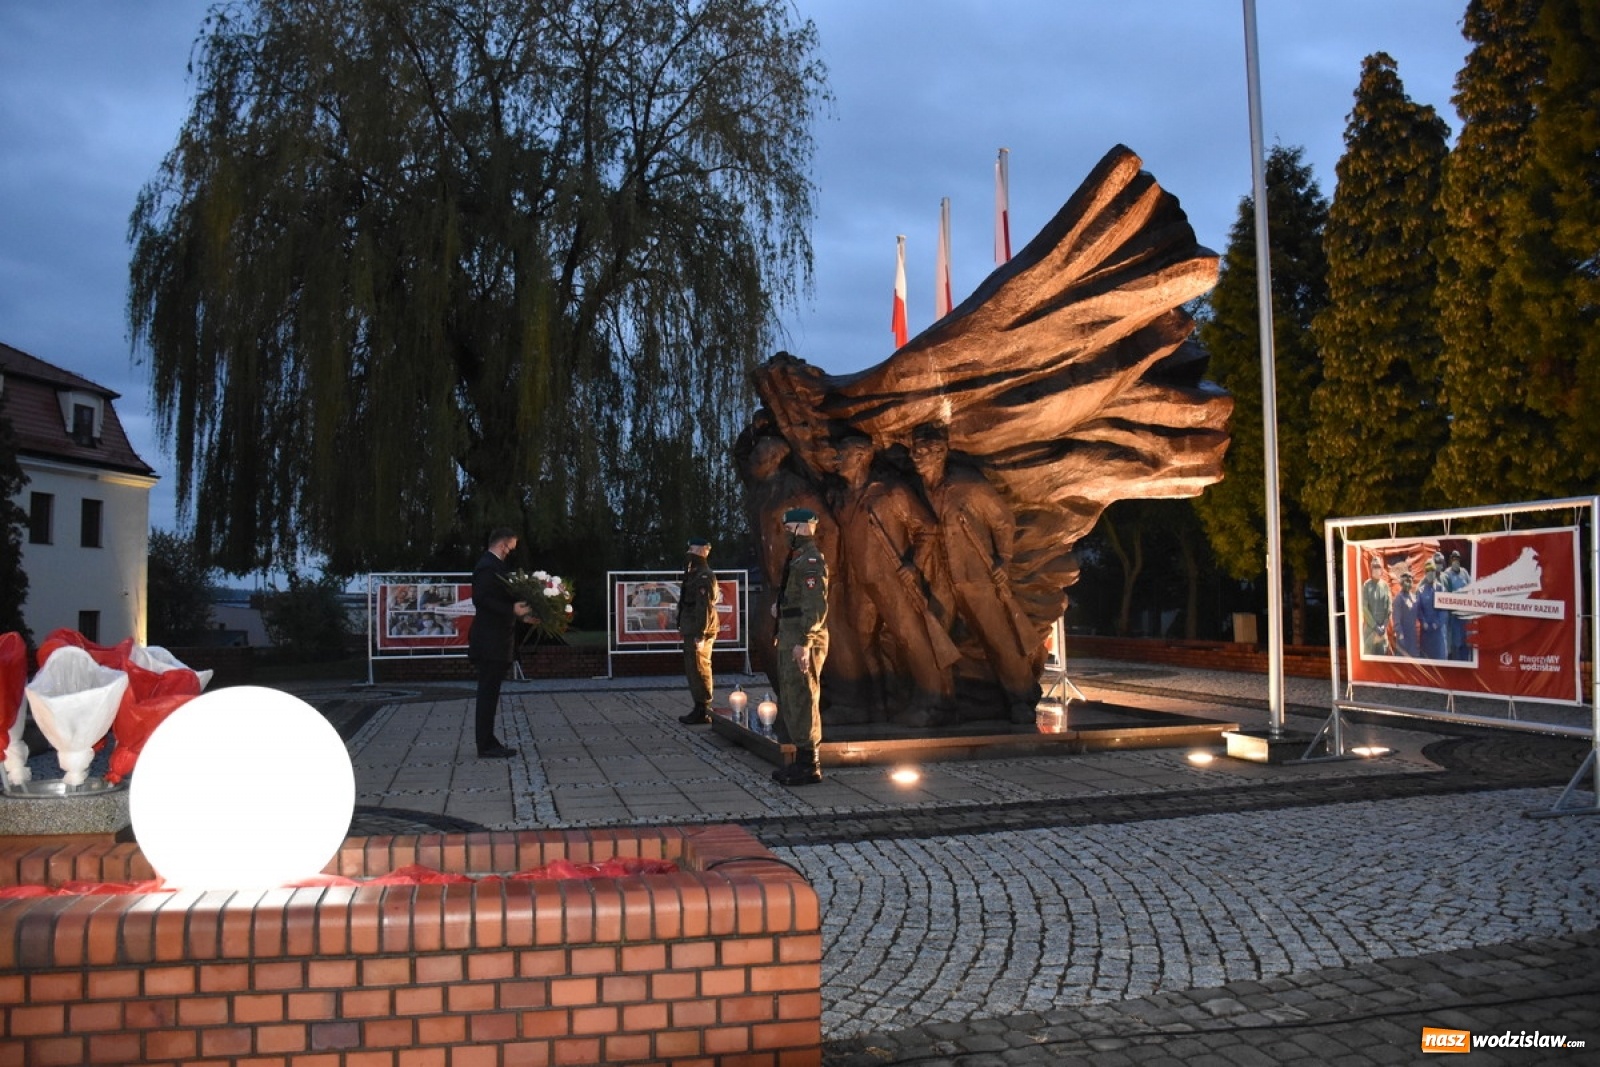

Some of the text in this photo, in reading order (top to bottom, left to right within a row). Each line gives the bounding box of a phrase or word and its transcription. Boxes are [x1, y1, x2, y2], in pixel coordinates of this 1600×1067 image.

[1483, 587, 1496, 595] maja
[1438, 597, 1560, 613] NIEBAWEM ZNÓW BĘDZIEMY RAZEM
